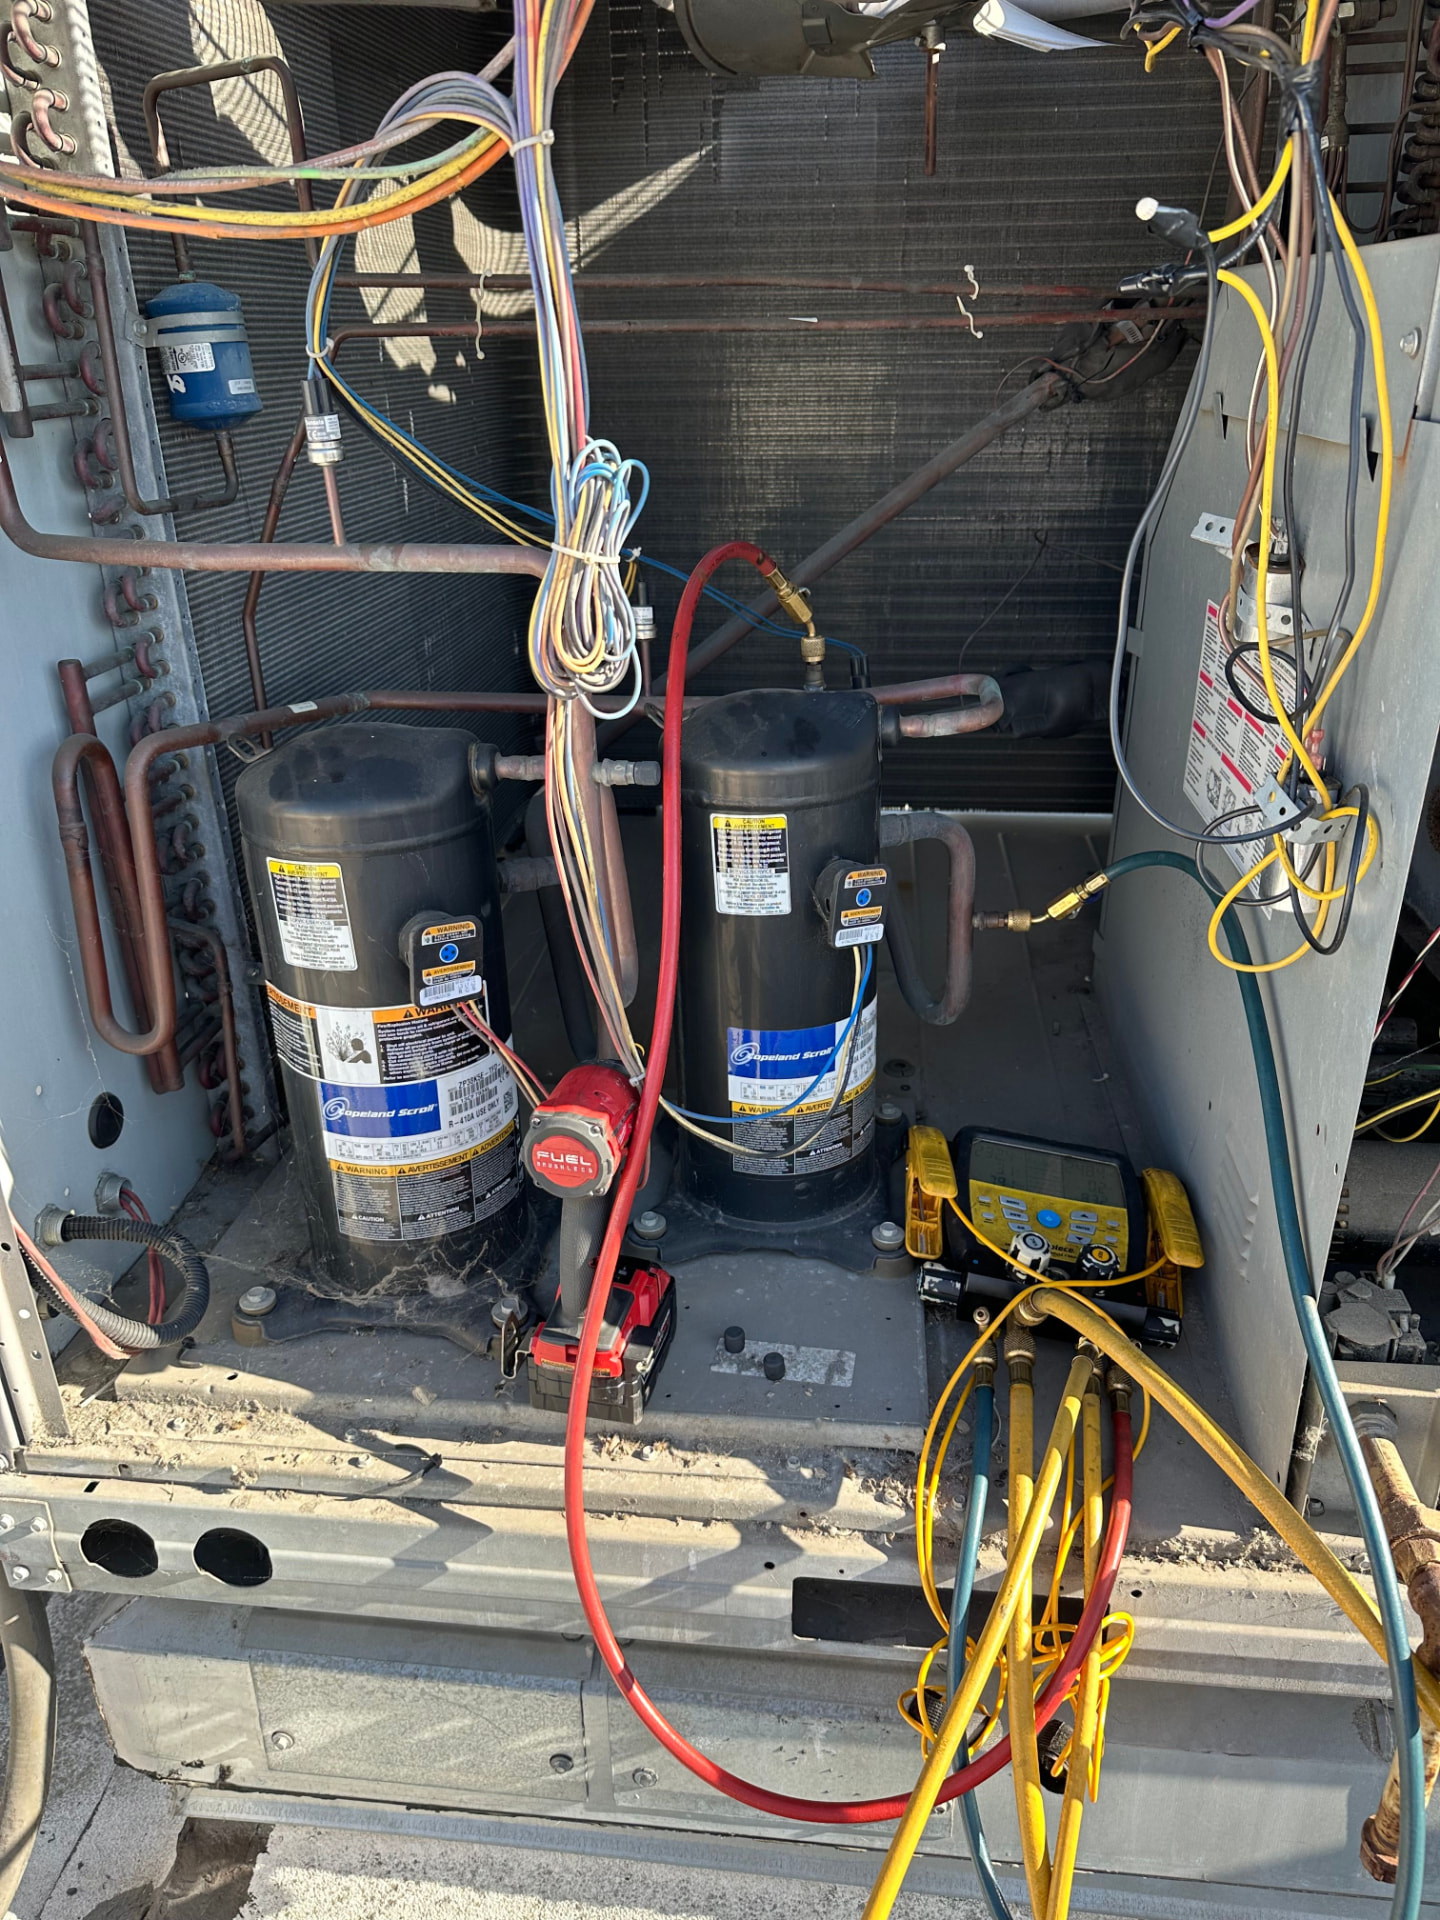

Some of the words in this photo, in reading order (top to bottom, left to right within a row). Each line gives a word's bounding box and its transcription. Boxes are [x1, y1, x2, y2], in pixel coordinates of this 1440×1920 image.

[857, 870, 883, 878] WARNING
[437, 922, 470, 933] WARNING
[802, 1047, 833, 1059] Scroll
[398, 1104, 434, 1117] Scroll
[448, 1113, 474, 1129] R-410A
[476, 1107, 487, 1118] USE
[488, 1097, 500, 1112] ONLY
[816, 1142, 843, 1154] ATTENTION
[345, 1164, 388, 1175] WARNING
[407, 1153, 468, 1174] AVERTISSEMENT
[536, 1150, 592, 1166] FUEL
[536, 1161, 593, 1174] BRUSHLESS
[358, 1214, 384, 1223] CAUTION
[426, 1206, 460, 1219] ATTENTION
